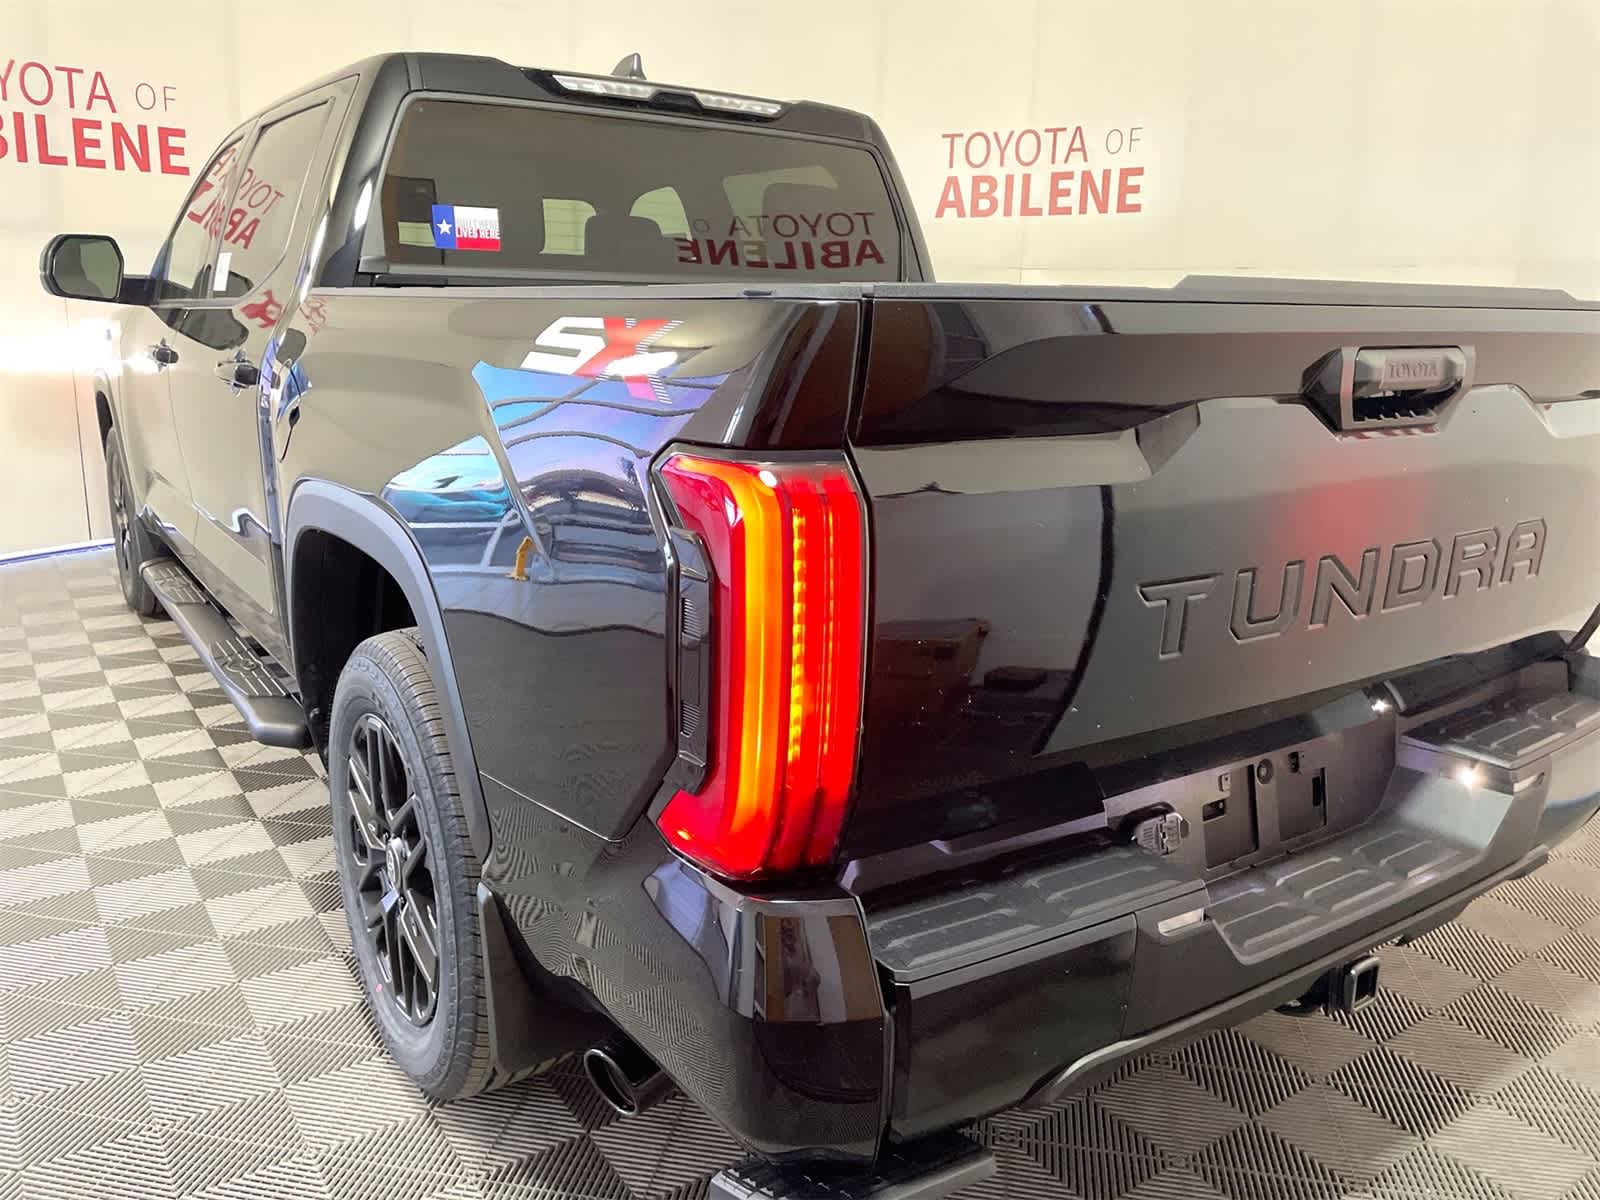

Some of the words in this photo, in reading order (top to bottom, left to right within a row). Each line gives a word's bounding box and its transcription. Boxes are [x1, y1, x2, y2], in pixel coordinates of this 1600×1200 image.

[135, 82, 177, 112] OF
[941, 125, 1089, 169] TOYOTA
[1105, 127, 1143, 155] OF
[934, 166, 1145, 218] ABILENE
[1387, 359, 1439, 379] TOYOTA
[1136, 517, 1548, 661] TUNDRA
